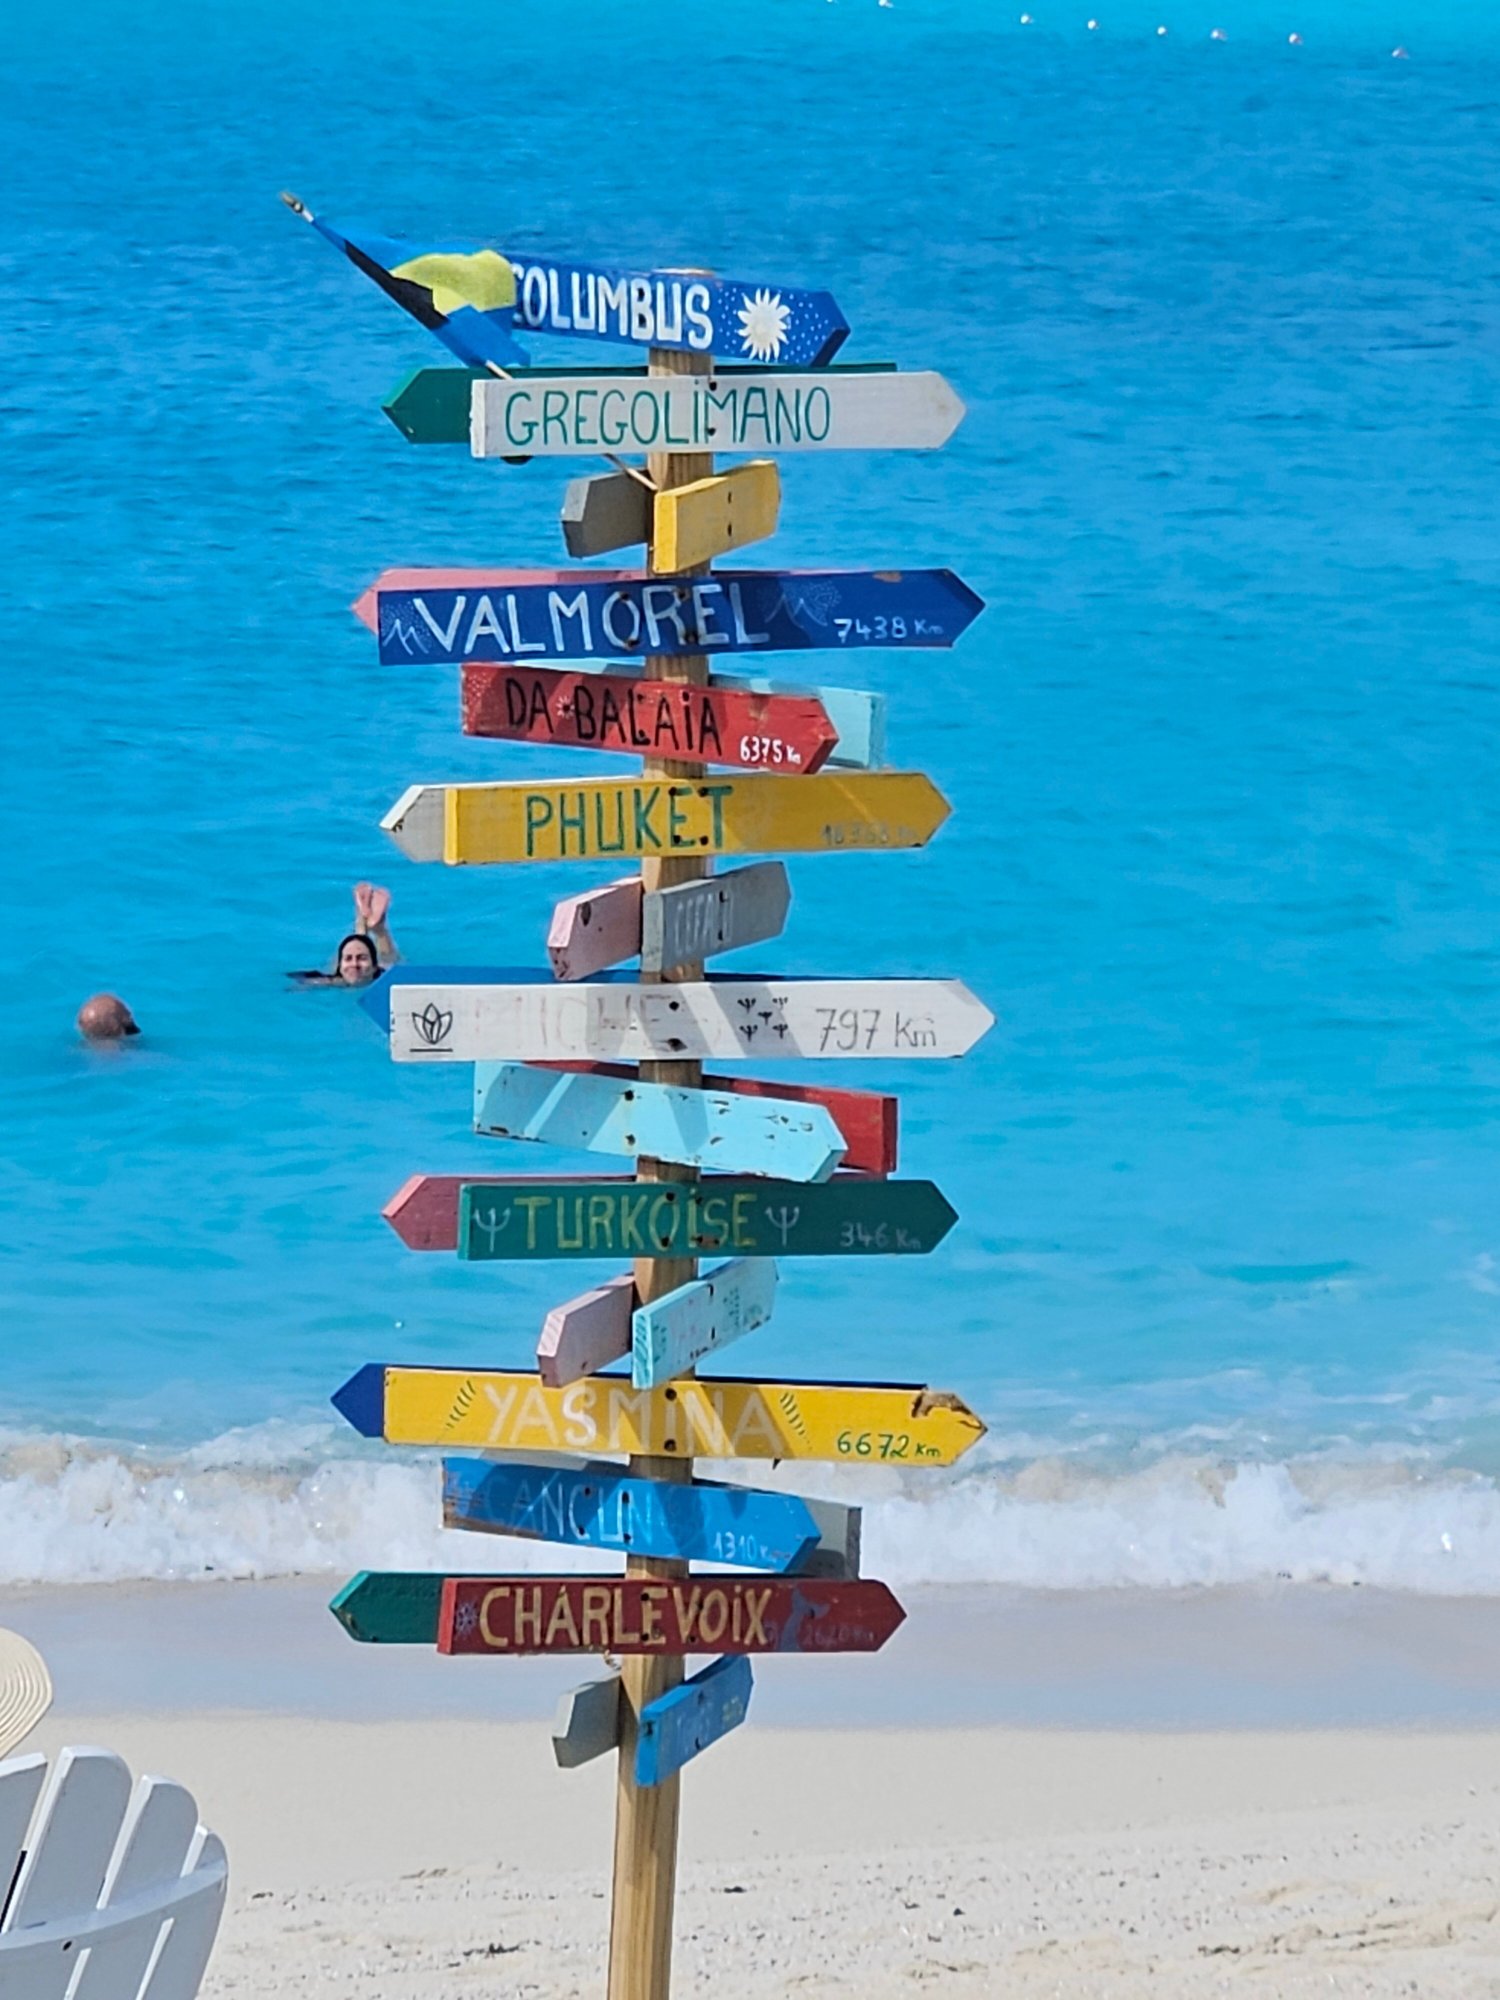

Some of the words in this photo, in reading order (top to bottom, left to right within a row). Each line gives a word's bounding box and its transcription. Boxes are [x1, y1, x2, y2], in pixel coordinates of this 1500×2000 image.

[413, 583, 770, 655] VALMOREL
[833, 616, 907, 643] 7438
[505, 677, 554, 734] DA
[740, 735, 783, 763] 6375
[527, 785, 733, 857] PHUKET
[815, 1008, 881, 1052] 797
[840, 1221, 889, 1248] 346
[837, 1430, 910, 1458] 6672
